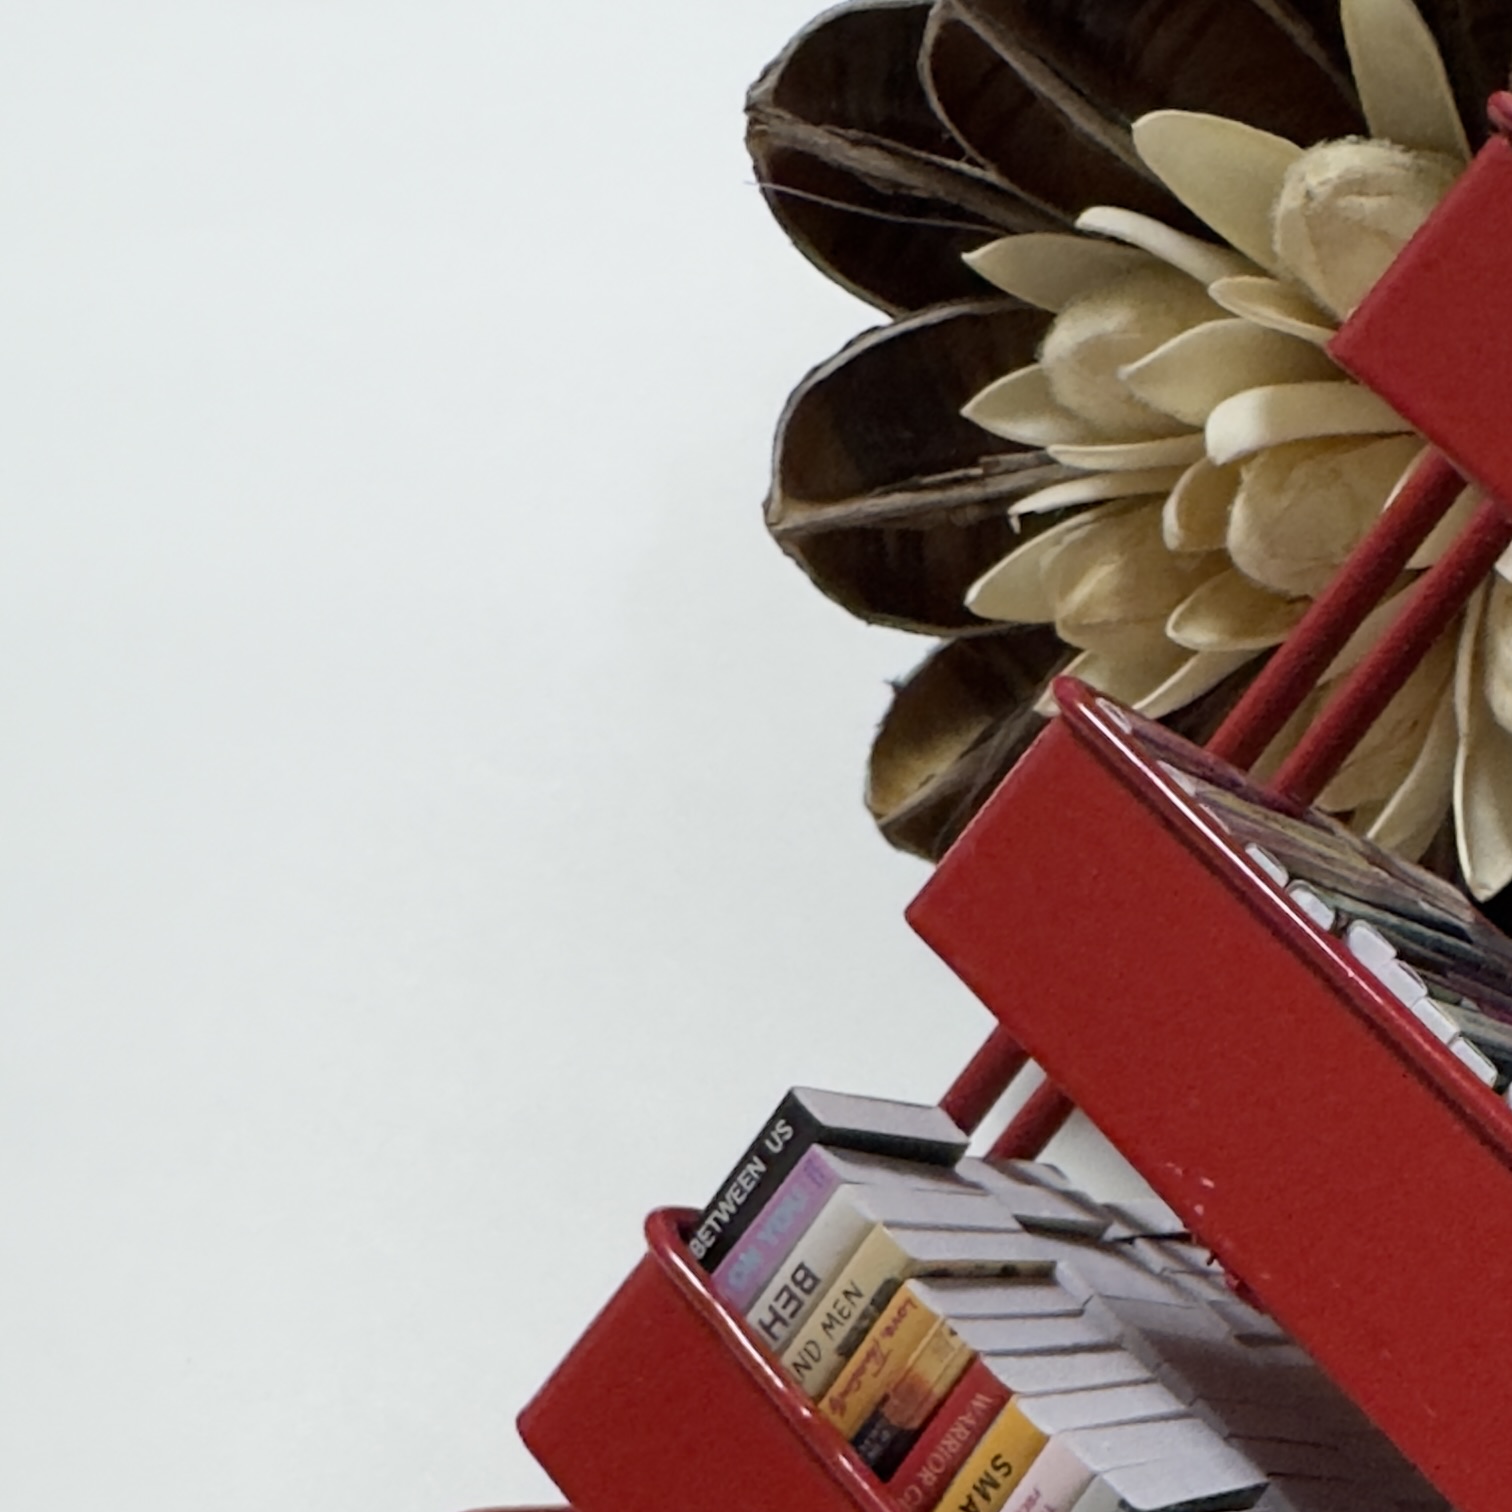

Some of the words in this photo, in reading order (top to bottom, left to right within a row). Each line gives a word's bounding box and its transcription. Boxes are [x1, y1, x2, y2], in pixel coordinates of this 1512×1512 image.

[684, 1154, 770, 1260] BETWEEN
[762, 1116, 797, 1155] US
[753, 1260, 824, 1342] BEH
[815, 1278, 869, 1340] MEN
[913, 1388, 994, 1489] WARRIOR
